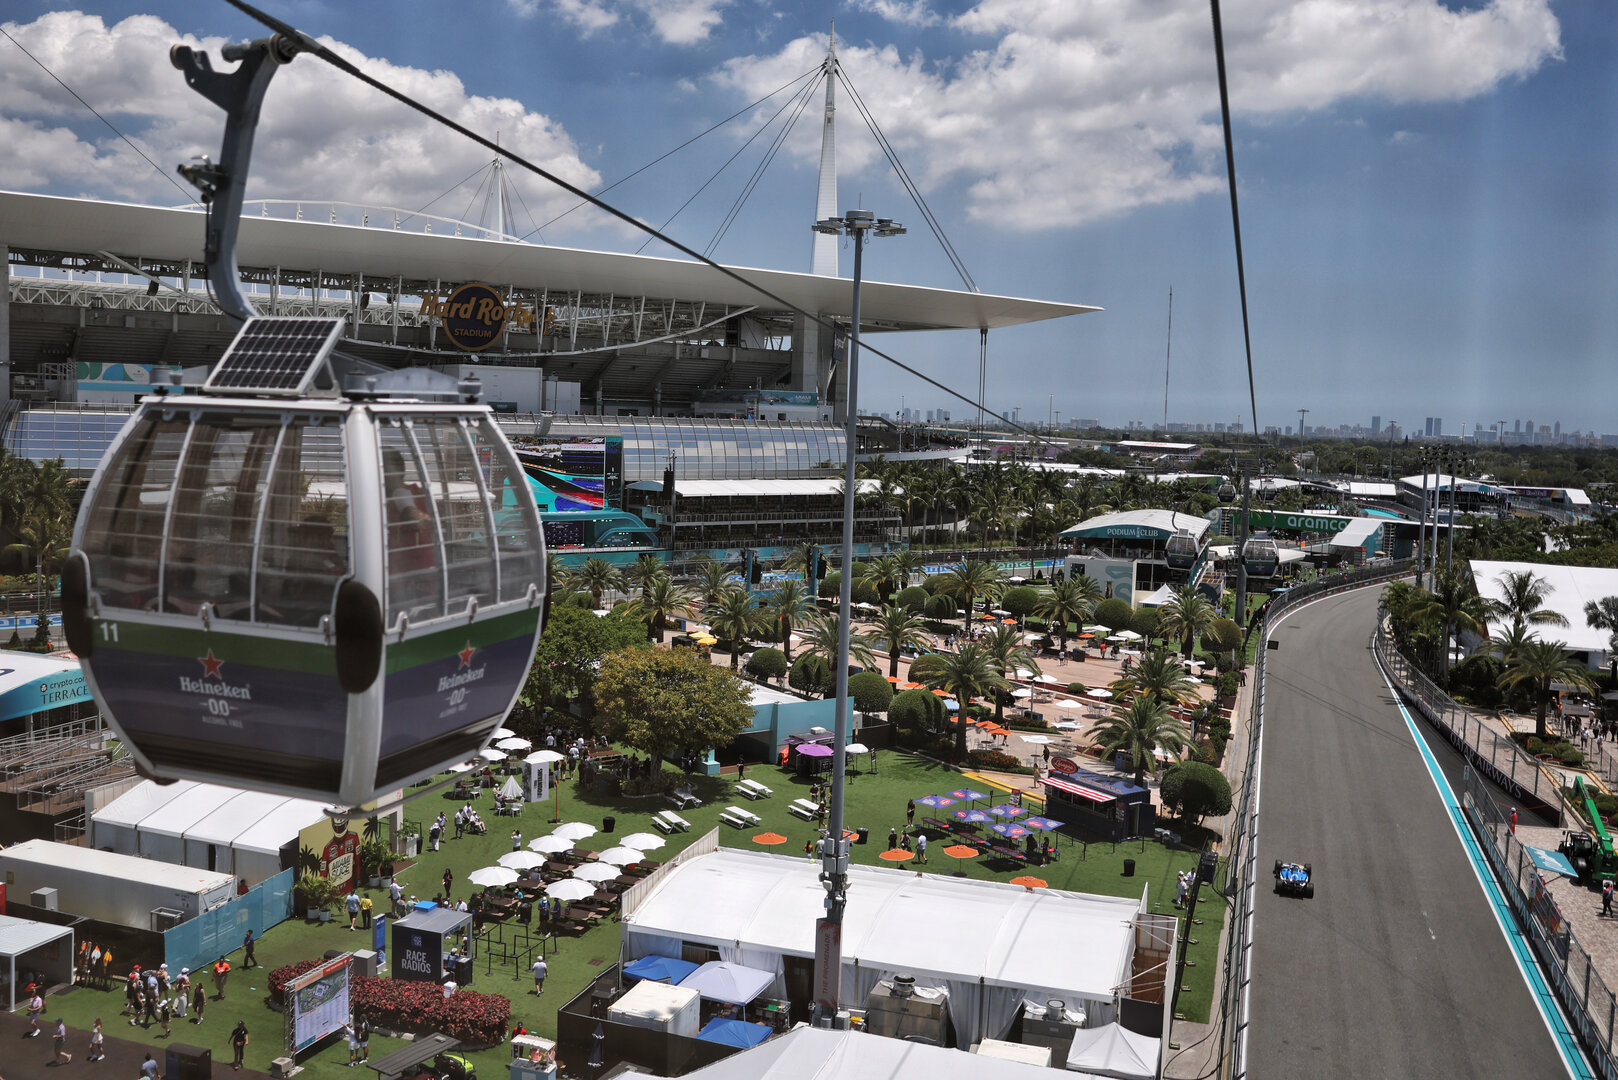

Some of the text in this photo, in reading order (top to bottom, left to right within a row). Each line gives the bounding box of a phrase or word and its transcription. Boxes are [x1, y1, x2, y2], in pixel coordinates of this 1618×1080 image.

[420, 292, 478, 320] Hard
[476, 297, 526, 327] Rock
[454, 328, 492, 338] STADIUM
[1210, 510, 1220, 524] 9
[1287, 515, 1347, 532] aramco
[1107, 528, 1159, 537] PODIUM CLUB
[1377, 523, 1385, 540] 9
[100, 621, 119, 642] 11
[179, 676, 252, 700] Heineken
[437, 668, 484, 692] Heineken
[41, 685, 89, 705] TERRACE
[1450, 732, 1521, 799] QATAR AIRWAYS
[406, 949, 427, 963] RACE
[823, 933, 831, 980] PROMENADE
[402, 959, 431, 974] RADIOS
[1552, 962, 1590, 1045] QATAR
